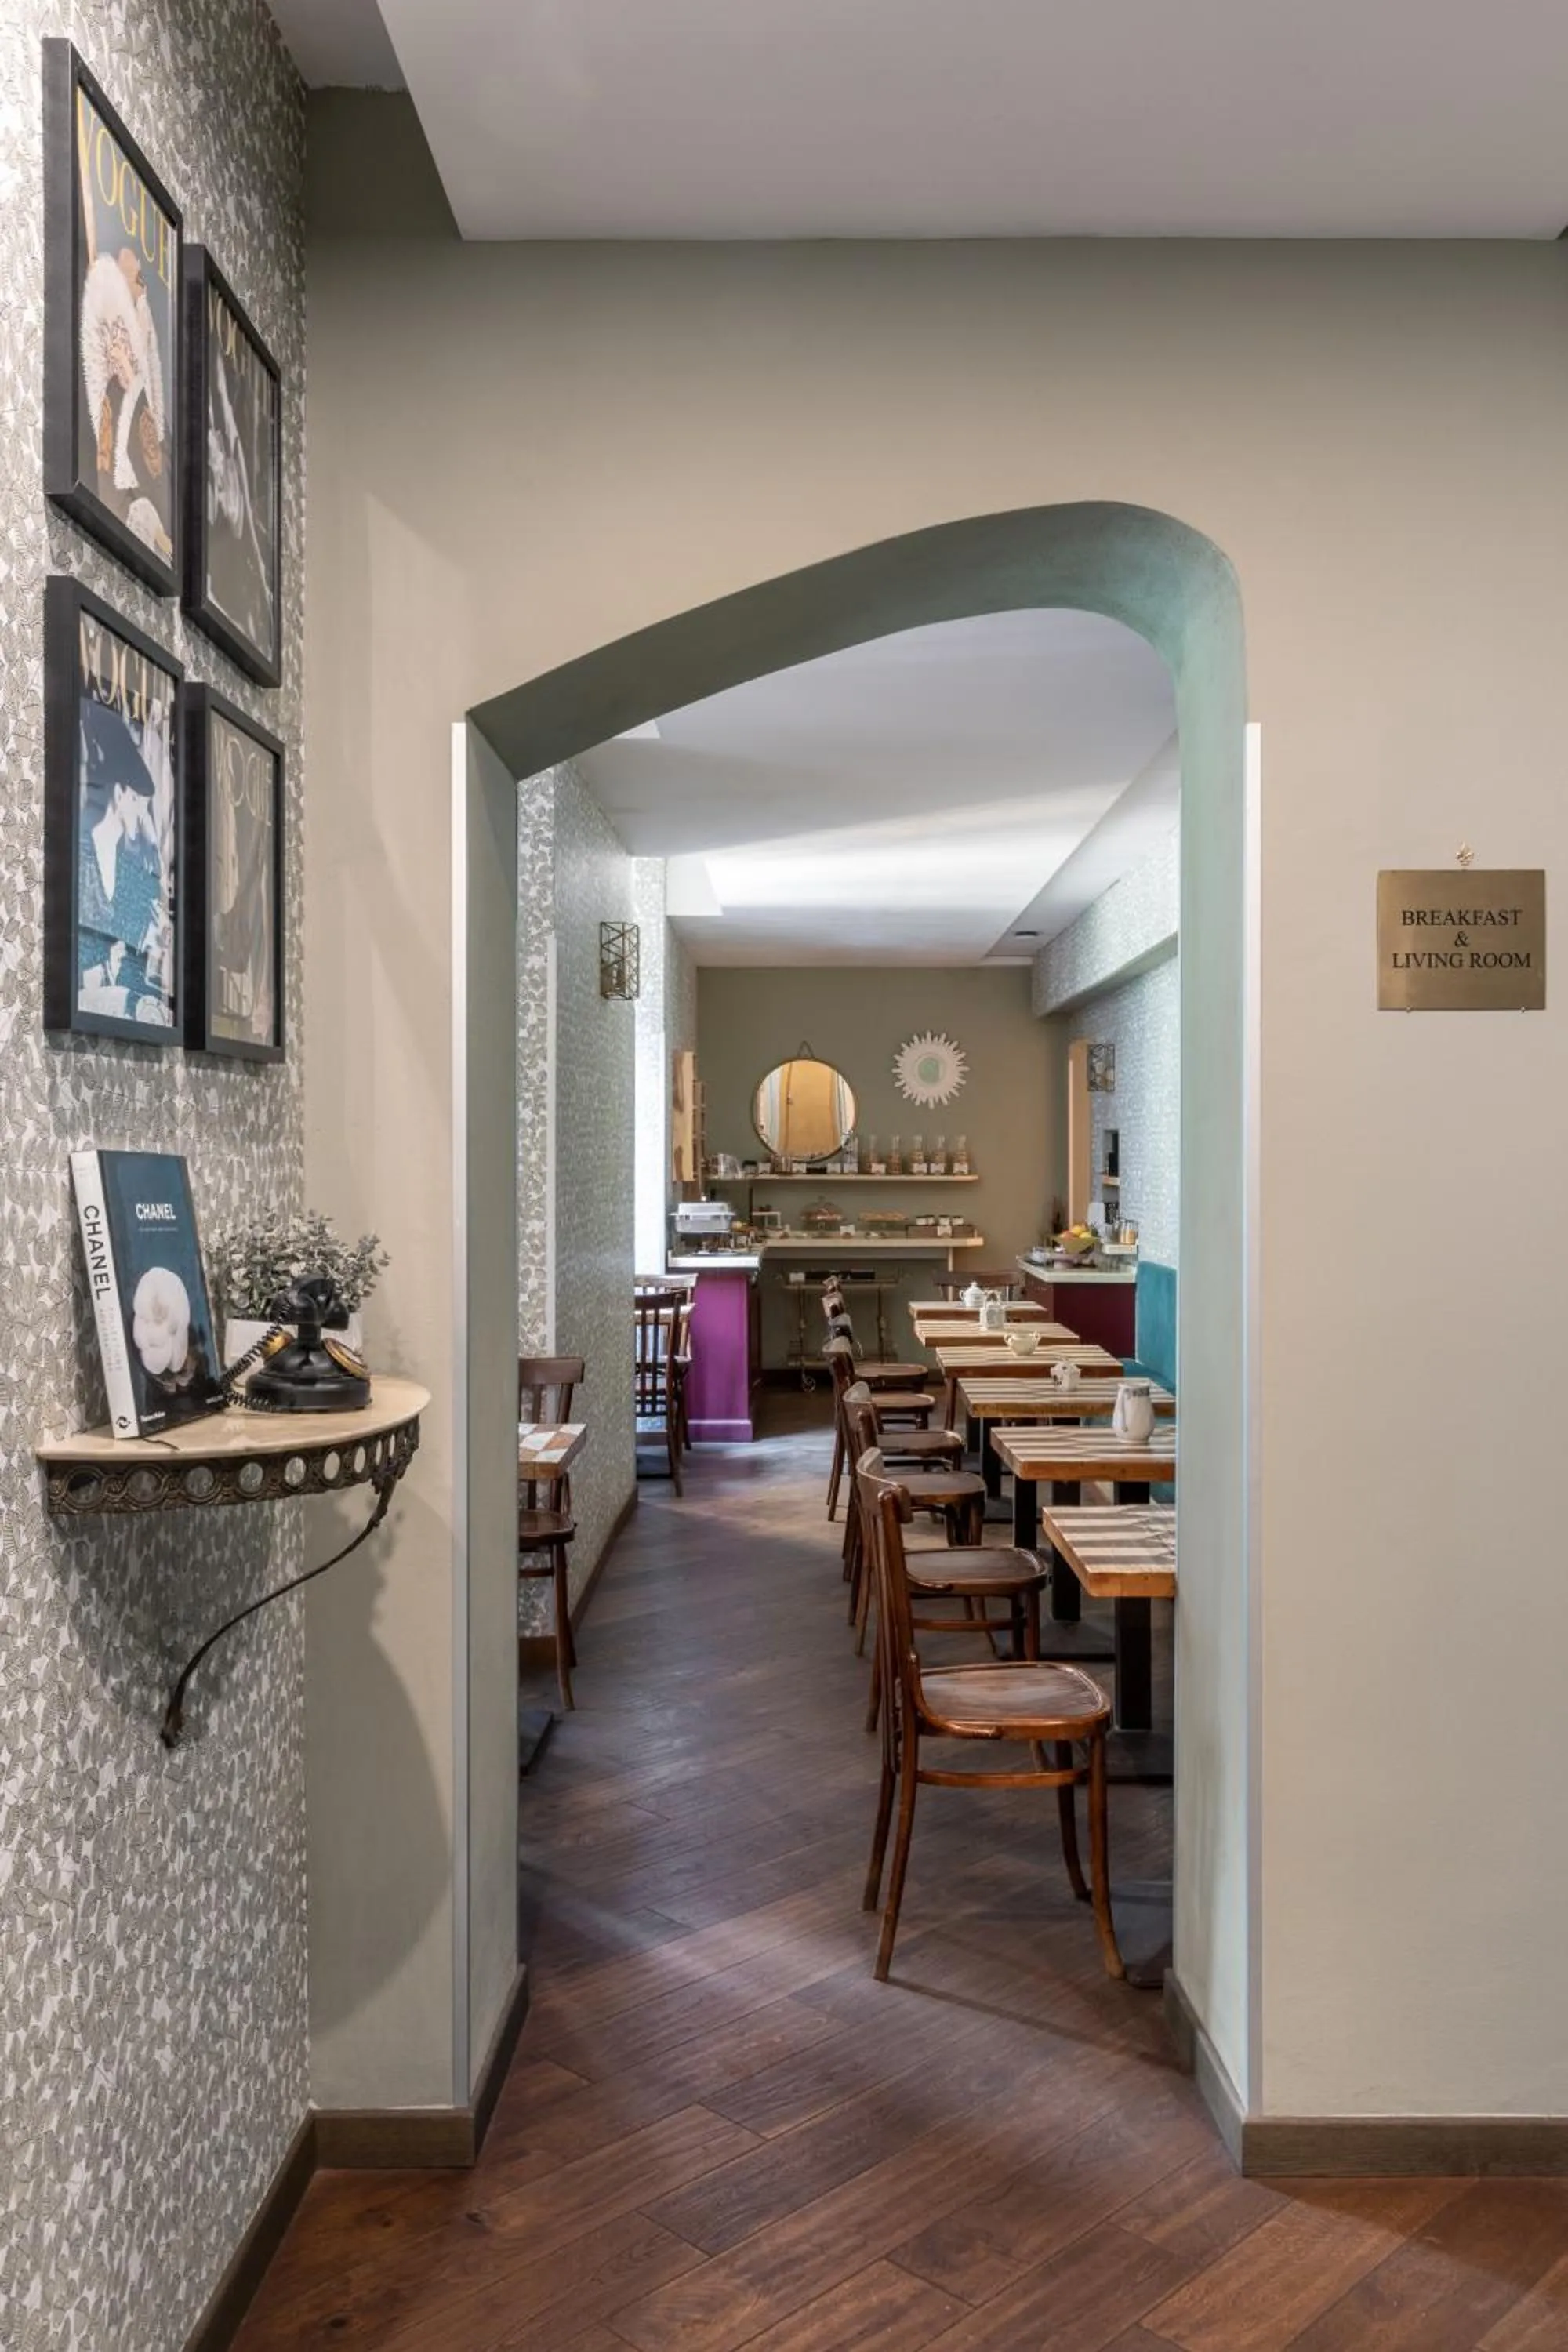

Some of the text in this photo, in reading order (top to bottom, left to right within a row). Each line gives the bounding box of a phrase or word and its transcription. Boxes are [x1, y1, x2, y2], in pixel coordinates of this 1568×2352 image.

[77, 86, 172, 292] VOGUE
[209, 280, 268, 416] VOG
[212, 720, 273, 827] VOGUE
[1402, 909, 1523, 926] BREAKFAST
[1454, 931, 1470, 947] &
[1392, 953, 1531, 968] LIVING ROOM
[136, 1203, 176, 1220] CHANEL
[84, 1205, 111, 1300] CHANEL
